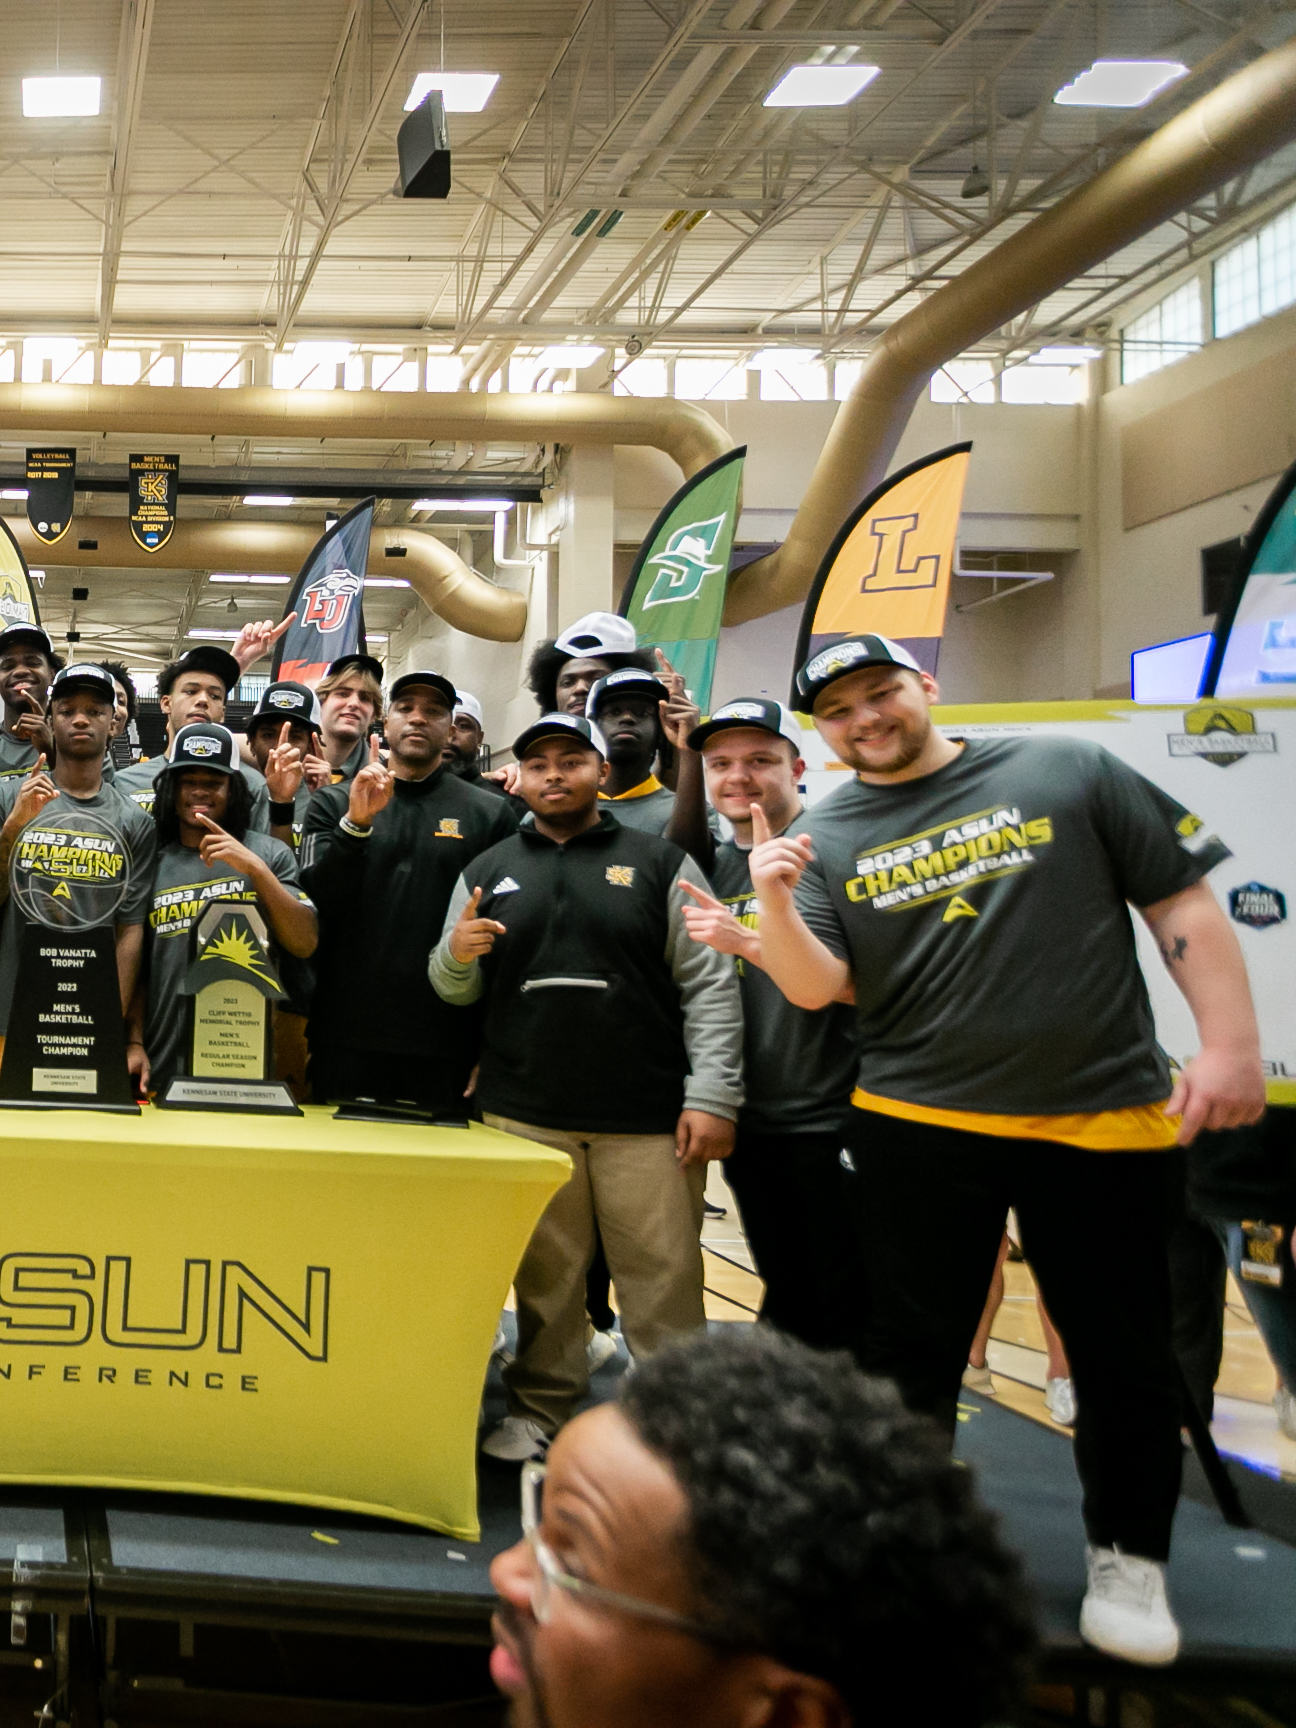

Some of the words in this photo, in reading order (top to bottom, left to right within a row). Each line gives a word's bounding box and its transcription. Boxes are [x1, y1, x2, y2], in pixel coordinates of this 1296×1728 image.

[131, 462, 177, 470] BASKETBALL
[142, 524, 164, 532] 2004
[860, 512, 940, 593] L
[184, 738, 221, 752] CHAMPIONS
[22, 832, 66, 846] 2023
[70, 836, 116, 852] ASUN
[856, 839, 934, 876] 2023
[942, 807, 1022, 848] ASUN
[845, 816, 1053, 903] CHAMPIONS
[872, 884, 925, 910] MEN'S
[924, 848, 1035, 893] BASKETBALL
[154, 890, 194, 910] 2023
[200, 880, 244, 900] ASUN
[1238, 892, 1274, 904] FINAL
[156, 920, 182, 934] MEN'S
[40, 948, 58, 956] BOB
[58, 949, 96, 958] VANATTA
[51, 958, 84, 968] TROPHY
[57, 982, 77, 992] 2023
[53, 1004, 80, 1012] MEN'S
[38, 1014, 94, 1024] BASKETBALL
[200, 1018, 234, 1026] MEMORIAL
[36, 1034, 95, 1046] TOURNAMENT
[208, 1040, 250, 1048] BASKETBALL
[42, 1046, 88, 1056] CHAMPION
[200, 1052, 230, 1060] REGULAR
[182, 1088, 218, 1096] KENNESAW
[218, 1090, 238, 1098] STATE
[239, 1091, 276, 1099] UNIVERSITY
